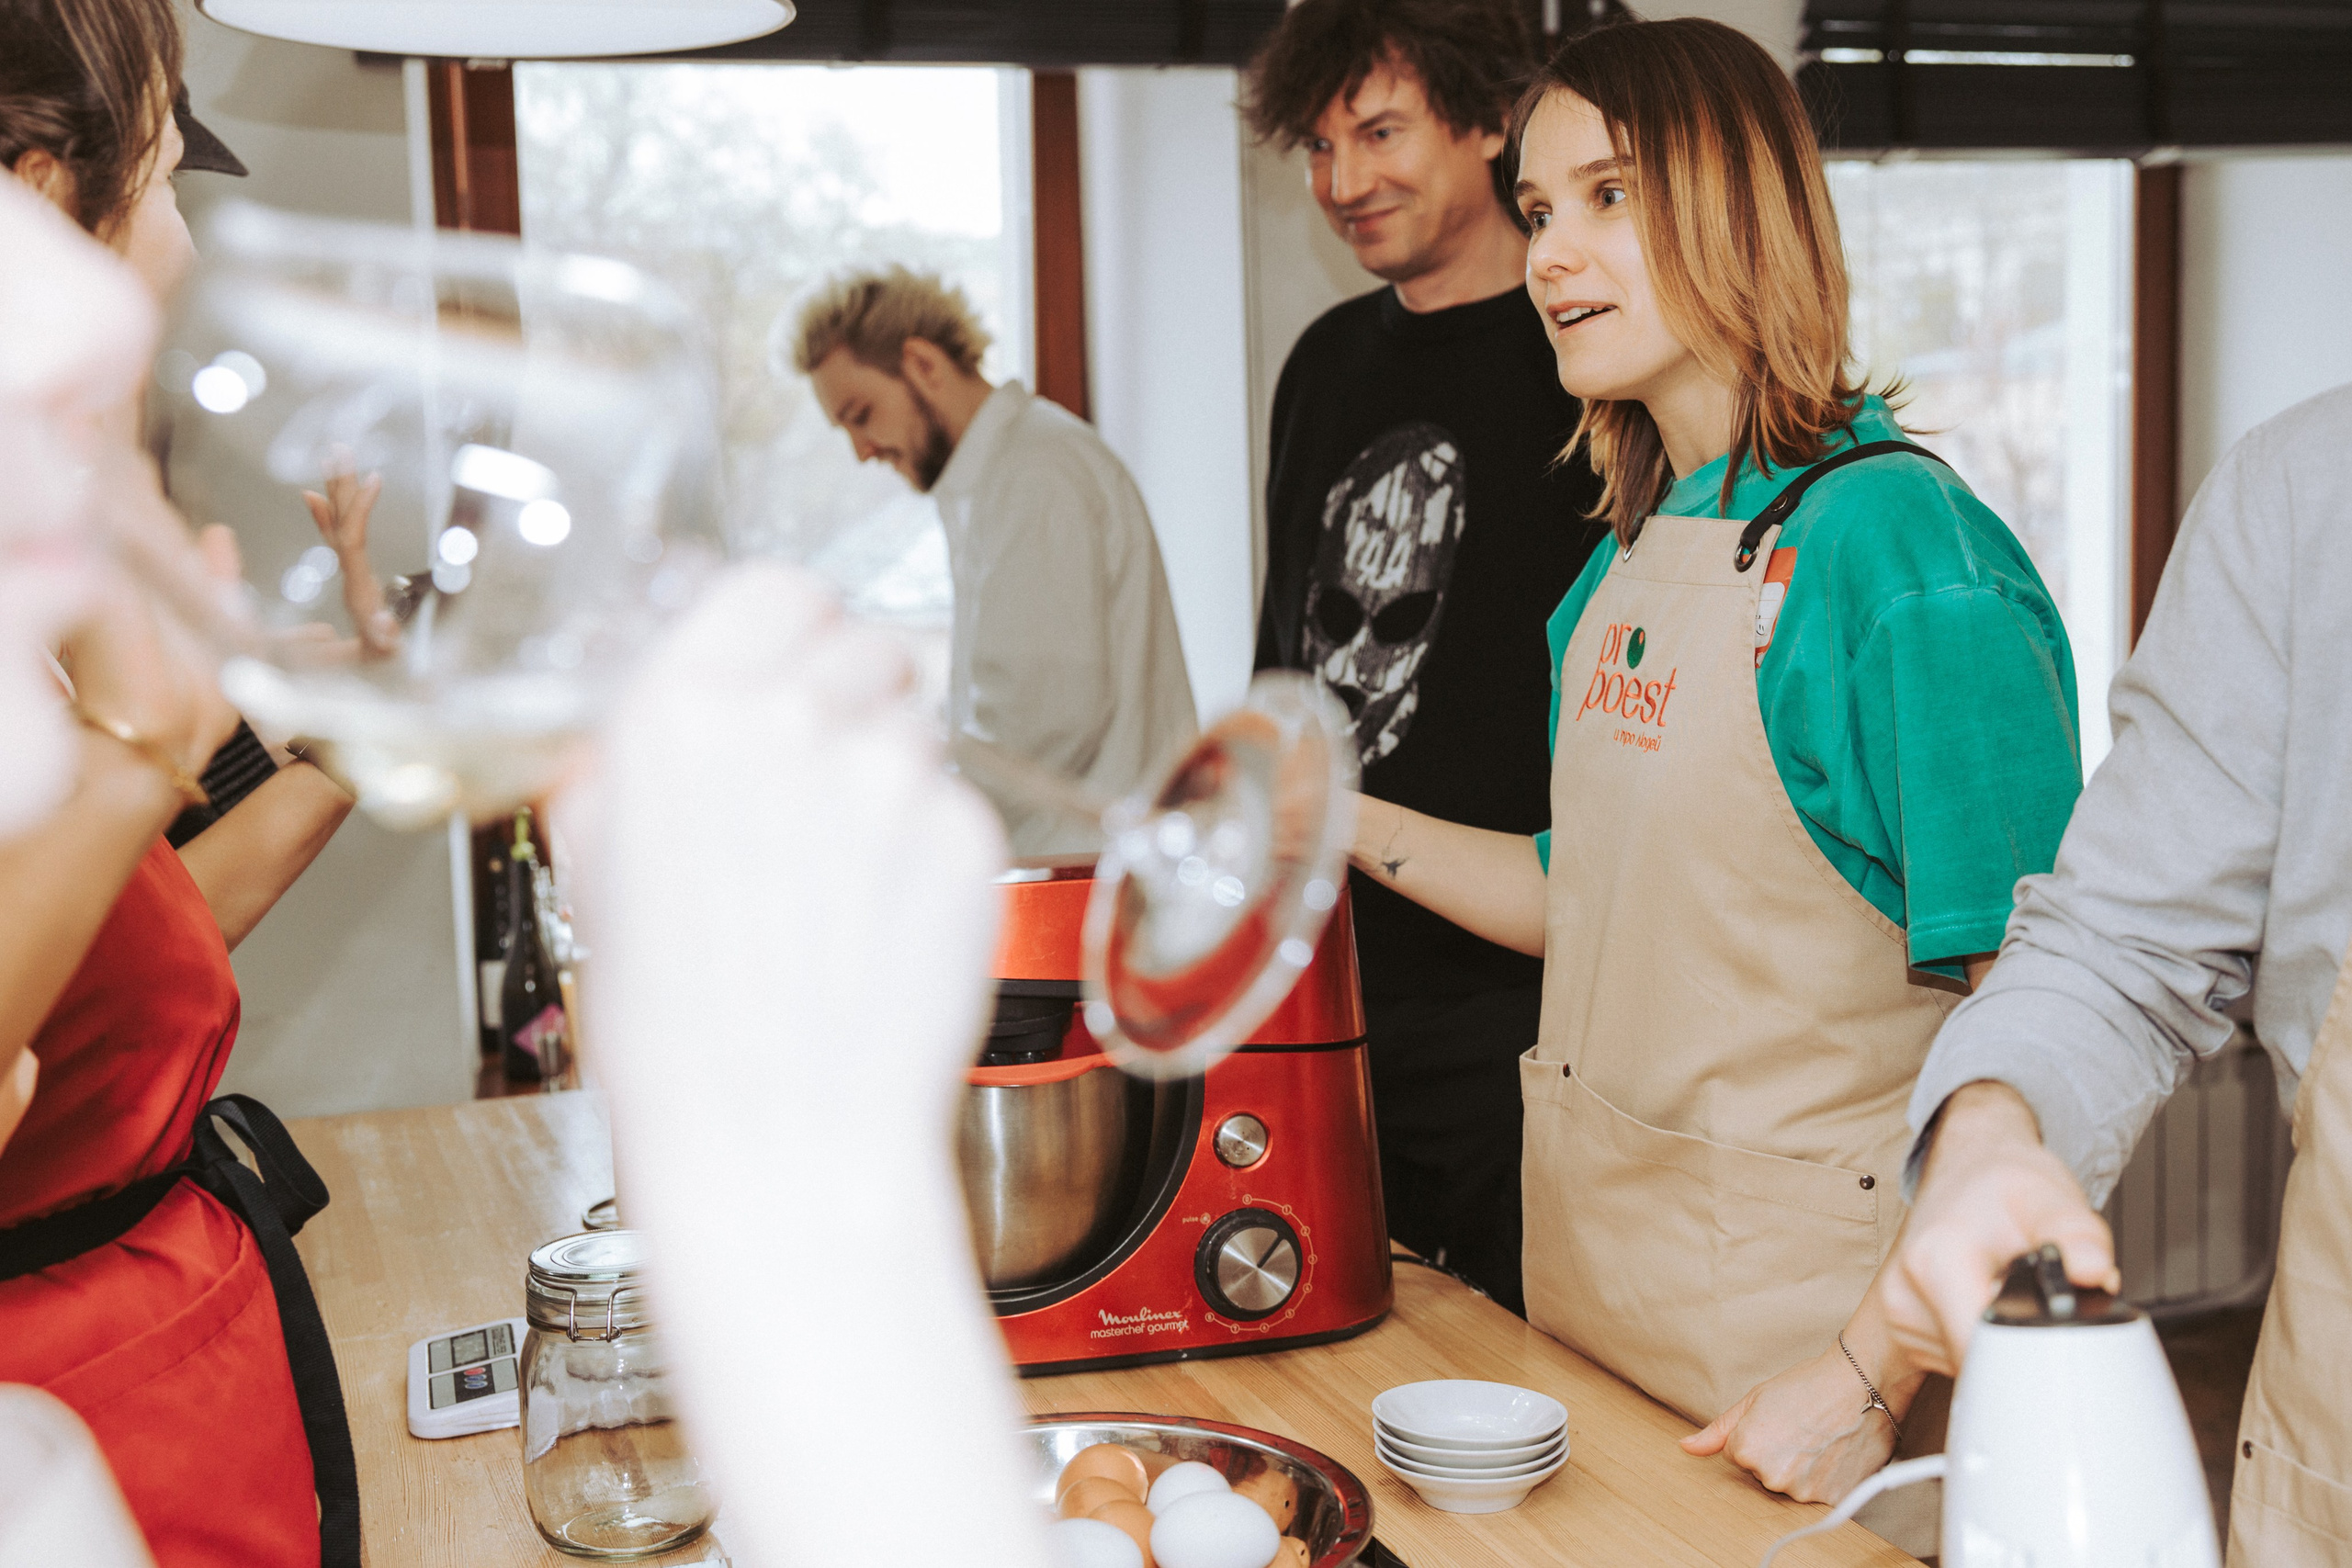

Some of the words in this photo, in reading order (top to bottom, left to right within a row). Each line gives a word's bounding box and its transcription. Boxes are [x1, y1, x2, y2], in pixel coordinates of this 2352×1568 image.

[1597, 623, 1645, 669] pro
[1576, 667, 1677, 727] poest
[1620, 729, 1635, 747] про
[1098, 1306, 1182, 1325] Moulinex
[1091, 1323, 1146, 1338] masterchef
[1147, 1319, 1189, 1336] gourmet
